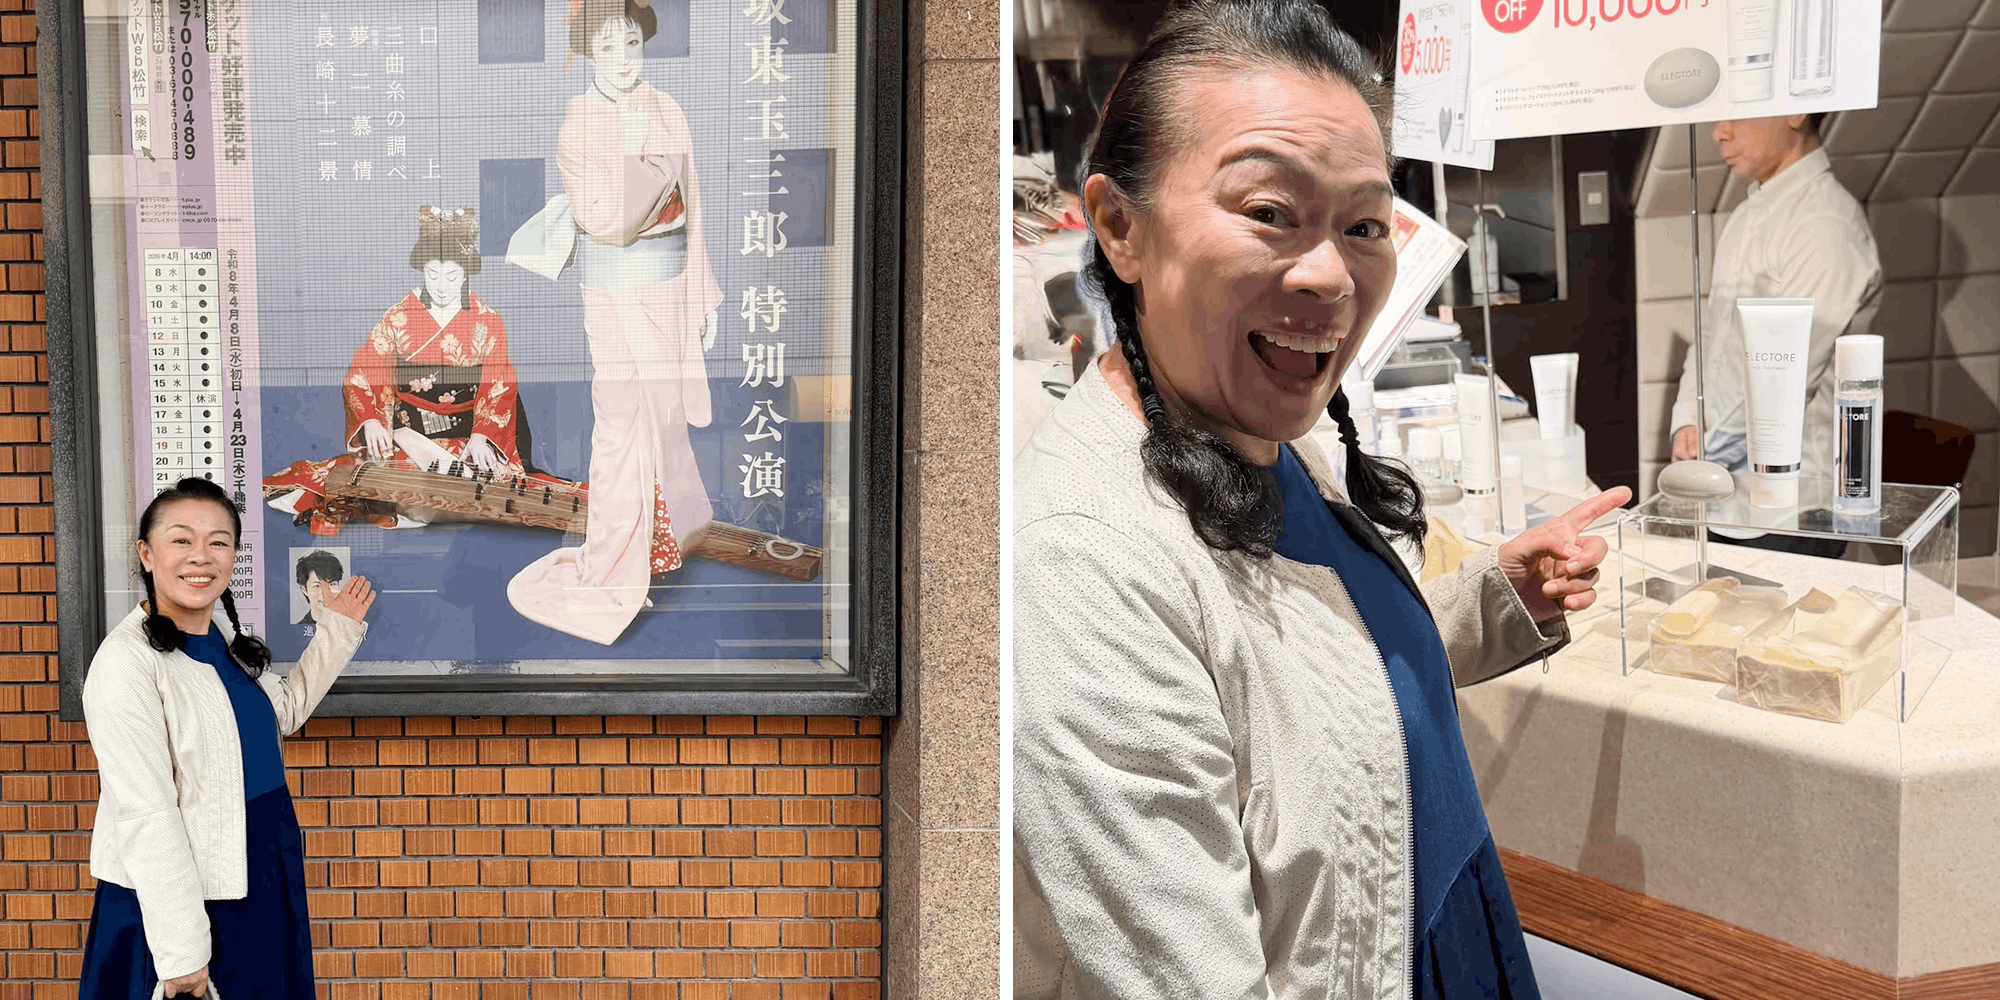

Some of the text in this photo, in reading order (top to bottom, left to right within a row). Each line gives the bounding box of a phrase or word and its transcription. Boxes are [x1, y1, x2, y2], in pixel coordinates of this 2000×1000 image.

[1494, 0, 1527, 23] OFF
[152, 0, 164, 51] トWeb松竹
[1660, 69, 1702, 82] ELECTORE
[316, 26, 338, 181] 長崎十二景
[350, 26, 372, 181] 夢二慕情
[385, 26, 407, 179] 三曲糸の調べ
[134, 115, 147, 141] 検索
[189, 252, 212, 260] 14:00
[155, 268, 178, 277] 8 水
[155, 284, 178, 293] 9 木
[150, 300, 179, 309] 10 金
[151, 316, 179, 325] 11 土
[152, 332, 179, 340] 12 日
[153, 347, 180, 356] 13 月
[1744, 351, 1796, 363] EECTORE
[153, 363, 181, 372] 14 火
[154, 379, 182, 388] 15 水
[739, 284, 788, 499] 特別公演
[154, 394, 217, 403] 16 木 休演
[155, 410, 183, 419] 17 金
[155, 426, 184, 434] 18 土
[155, 441, 183, 450] 19 日
[156, 456, 184, 465] 20 月
[156, 472, 185, 480] 21 火
